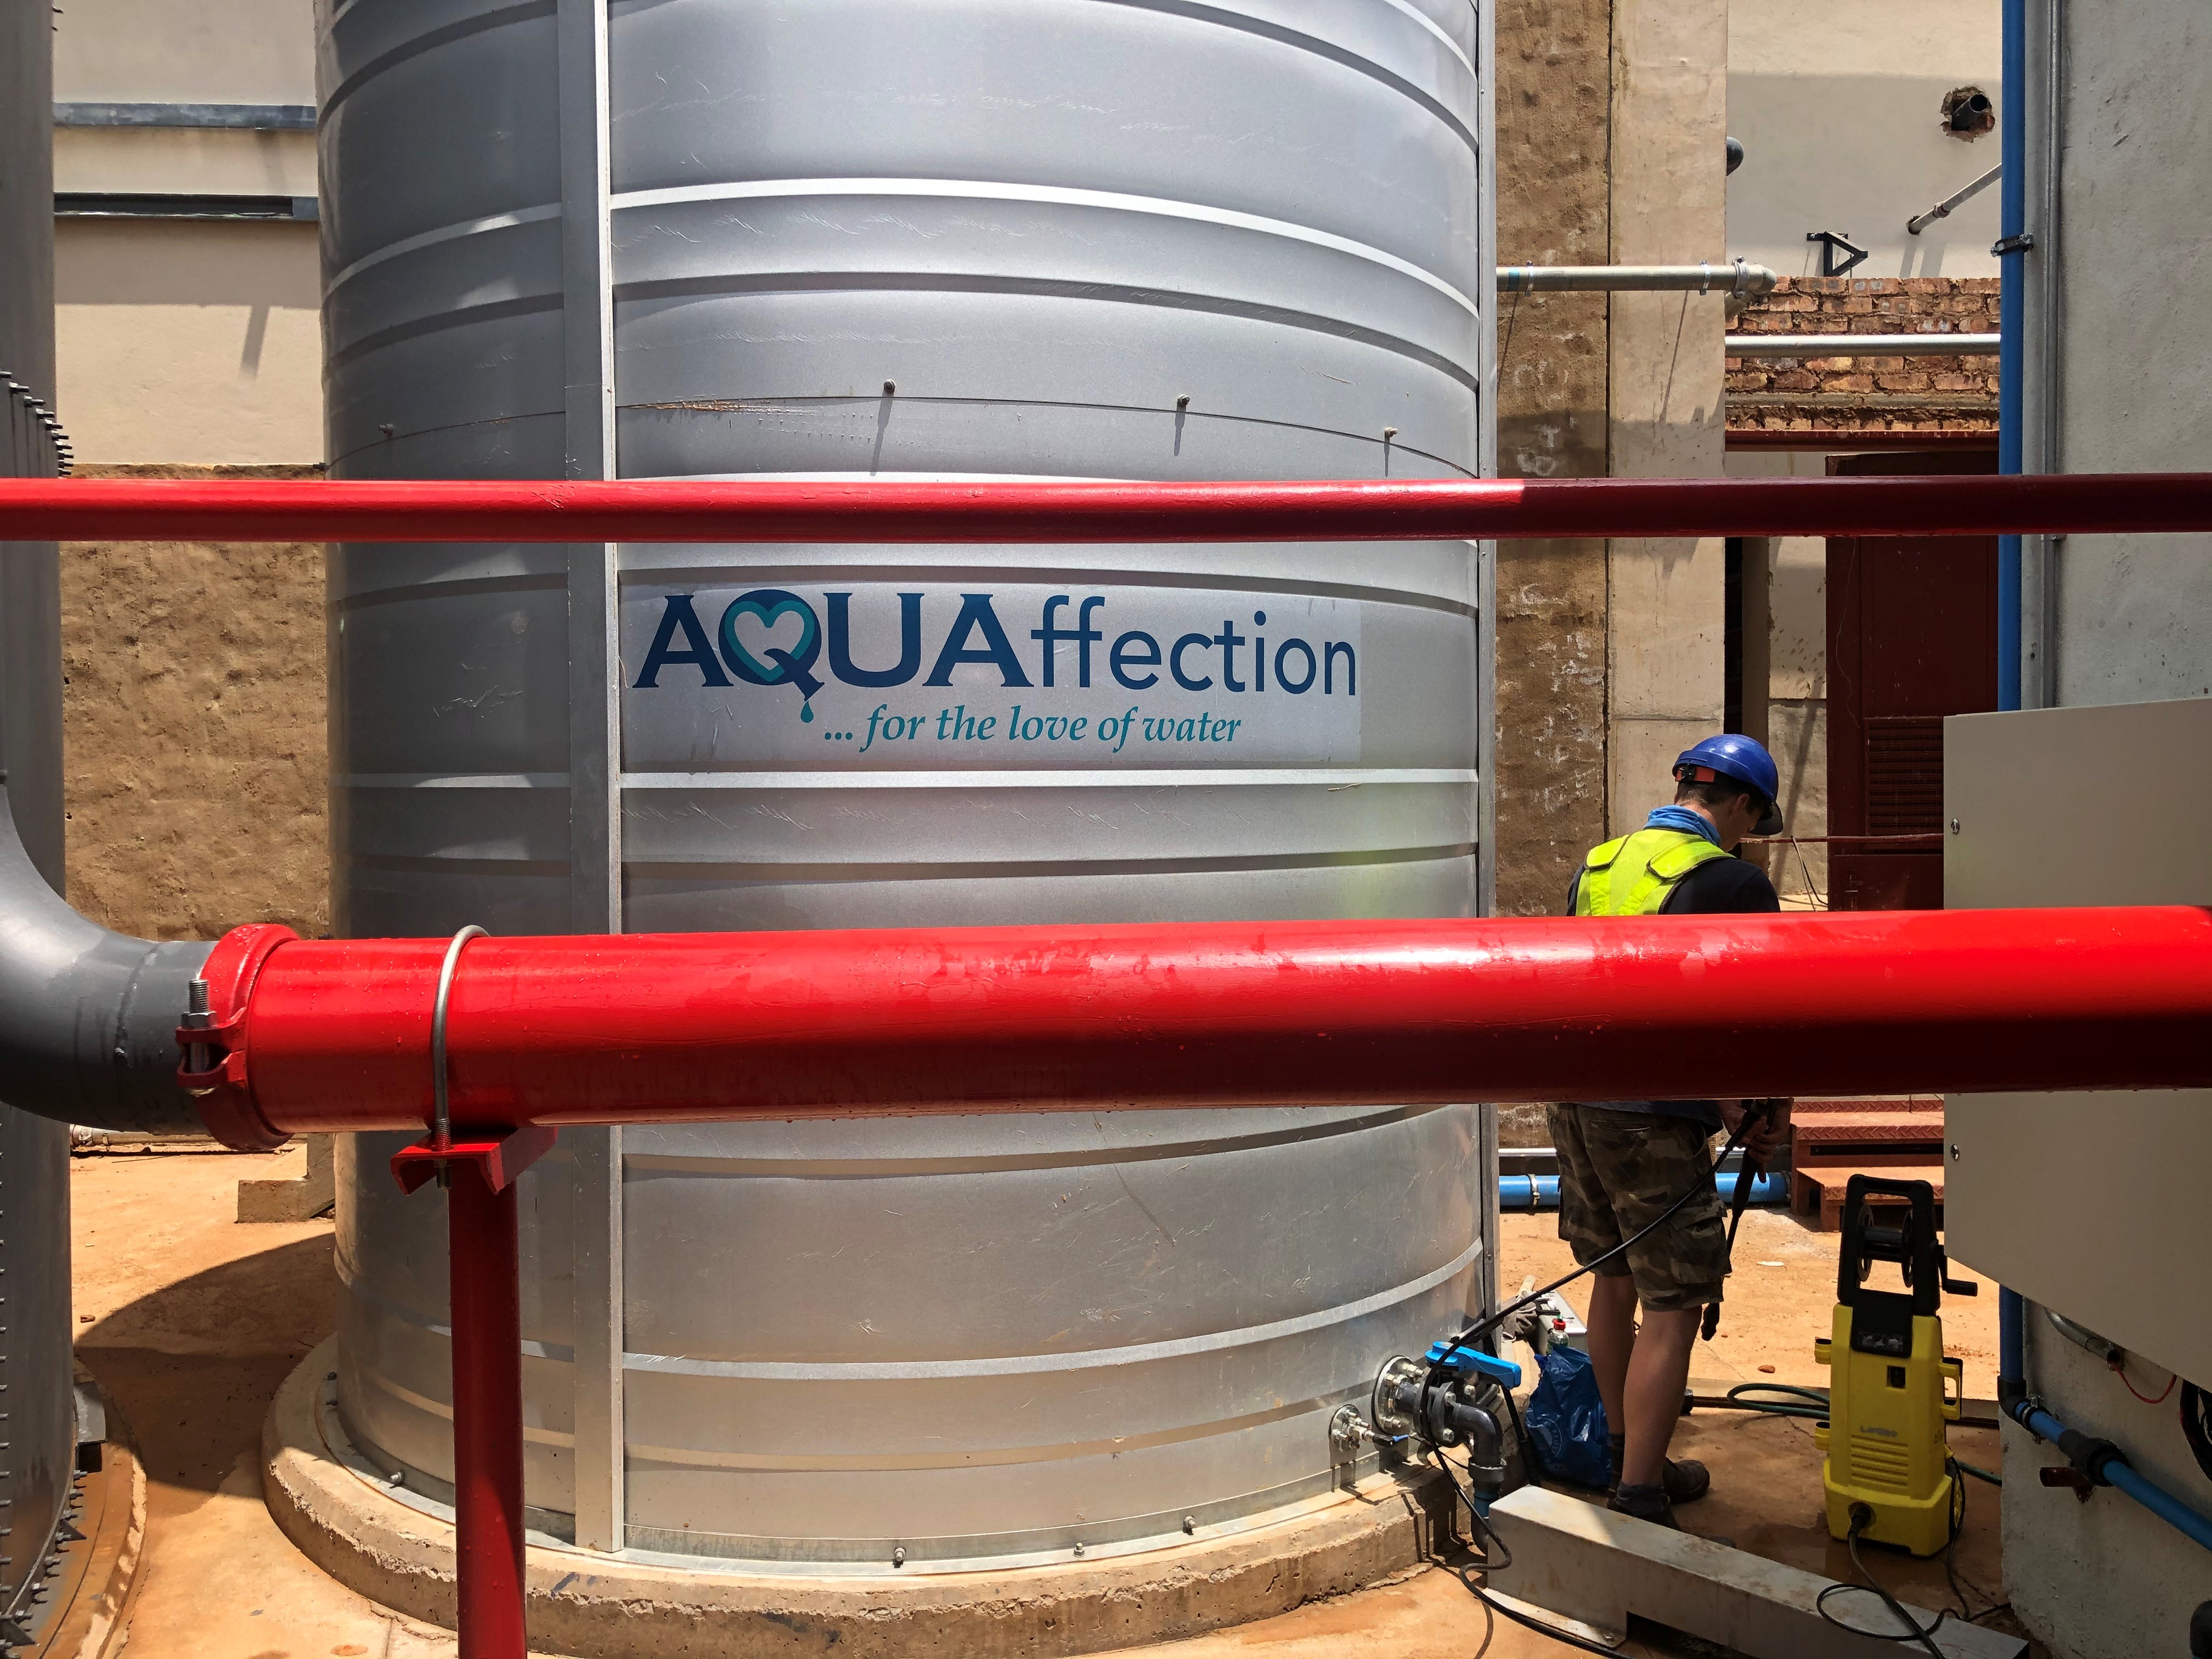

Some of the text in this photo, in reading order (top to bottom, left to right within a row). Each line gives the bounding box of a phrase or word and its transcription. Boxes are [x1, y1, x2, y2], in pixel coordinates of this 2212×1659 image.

[633, 589, 1356, 699] AQUAffection
[860, 704, 926, 753] for
[937, 708, 997, 741] the
[1009, 704, 1088, 742] love
[1098, 706, 1139, 754] of
[1143, 711, 1242, 743] water
